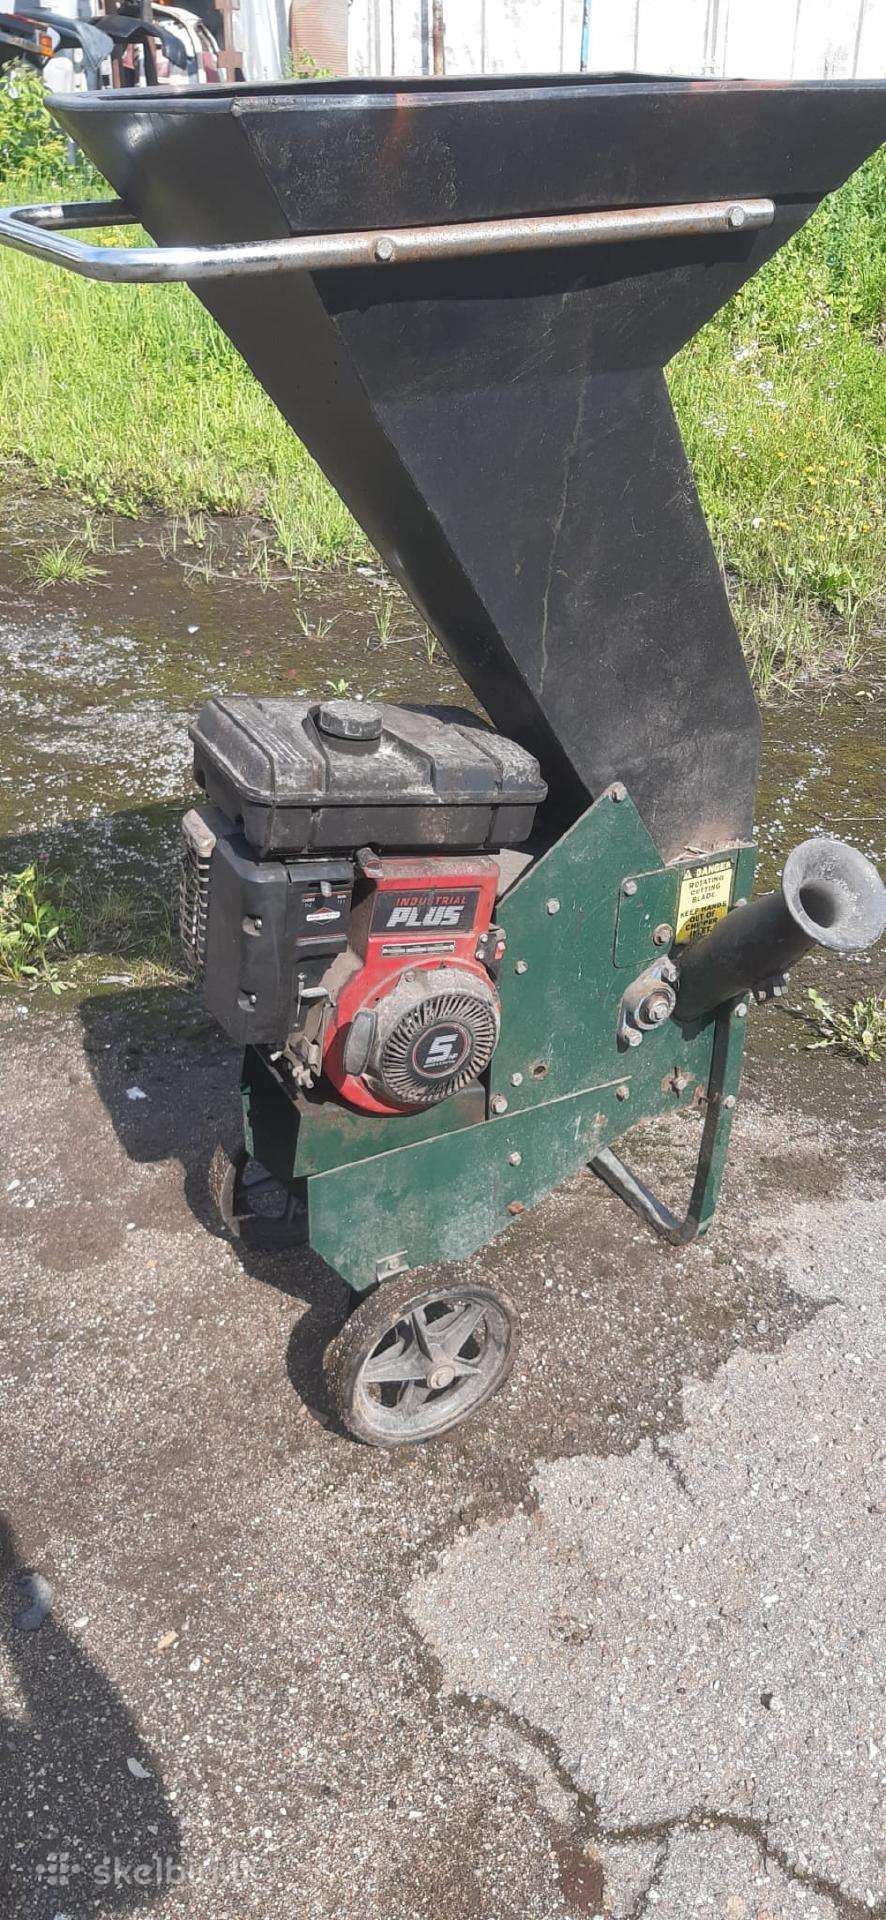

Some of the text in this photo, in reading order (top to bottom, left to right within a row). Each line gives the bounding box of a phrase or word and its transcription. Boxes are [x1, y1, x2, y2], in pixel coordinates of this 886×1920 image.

[696, 861, 732, 878] DANGER
[689, 875, 724, 889] ROTATING
[690, 884, 721, 896] CUTTING
[396, 895, 467, 906] INDUSTRIAL
[386, 905, 465, 928] PLUS
[680, 900, 727, 918] KEEP HANDS
[689, 909, 716, 923] OUT OF
[424, 1033, 459, 1065] 5
